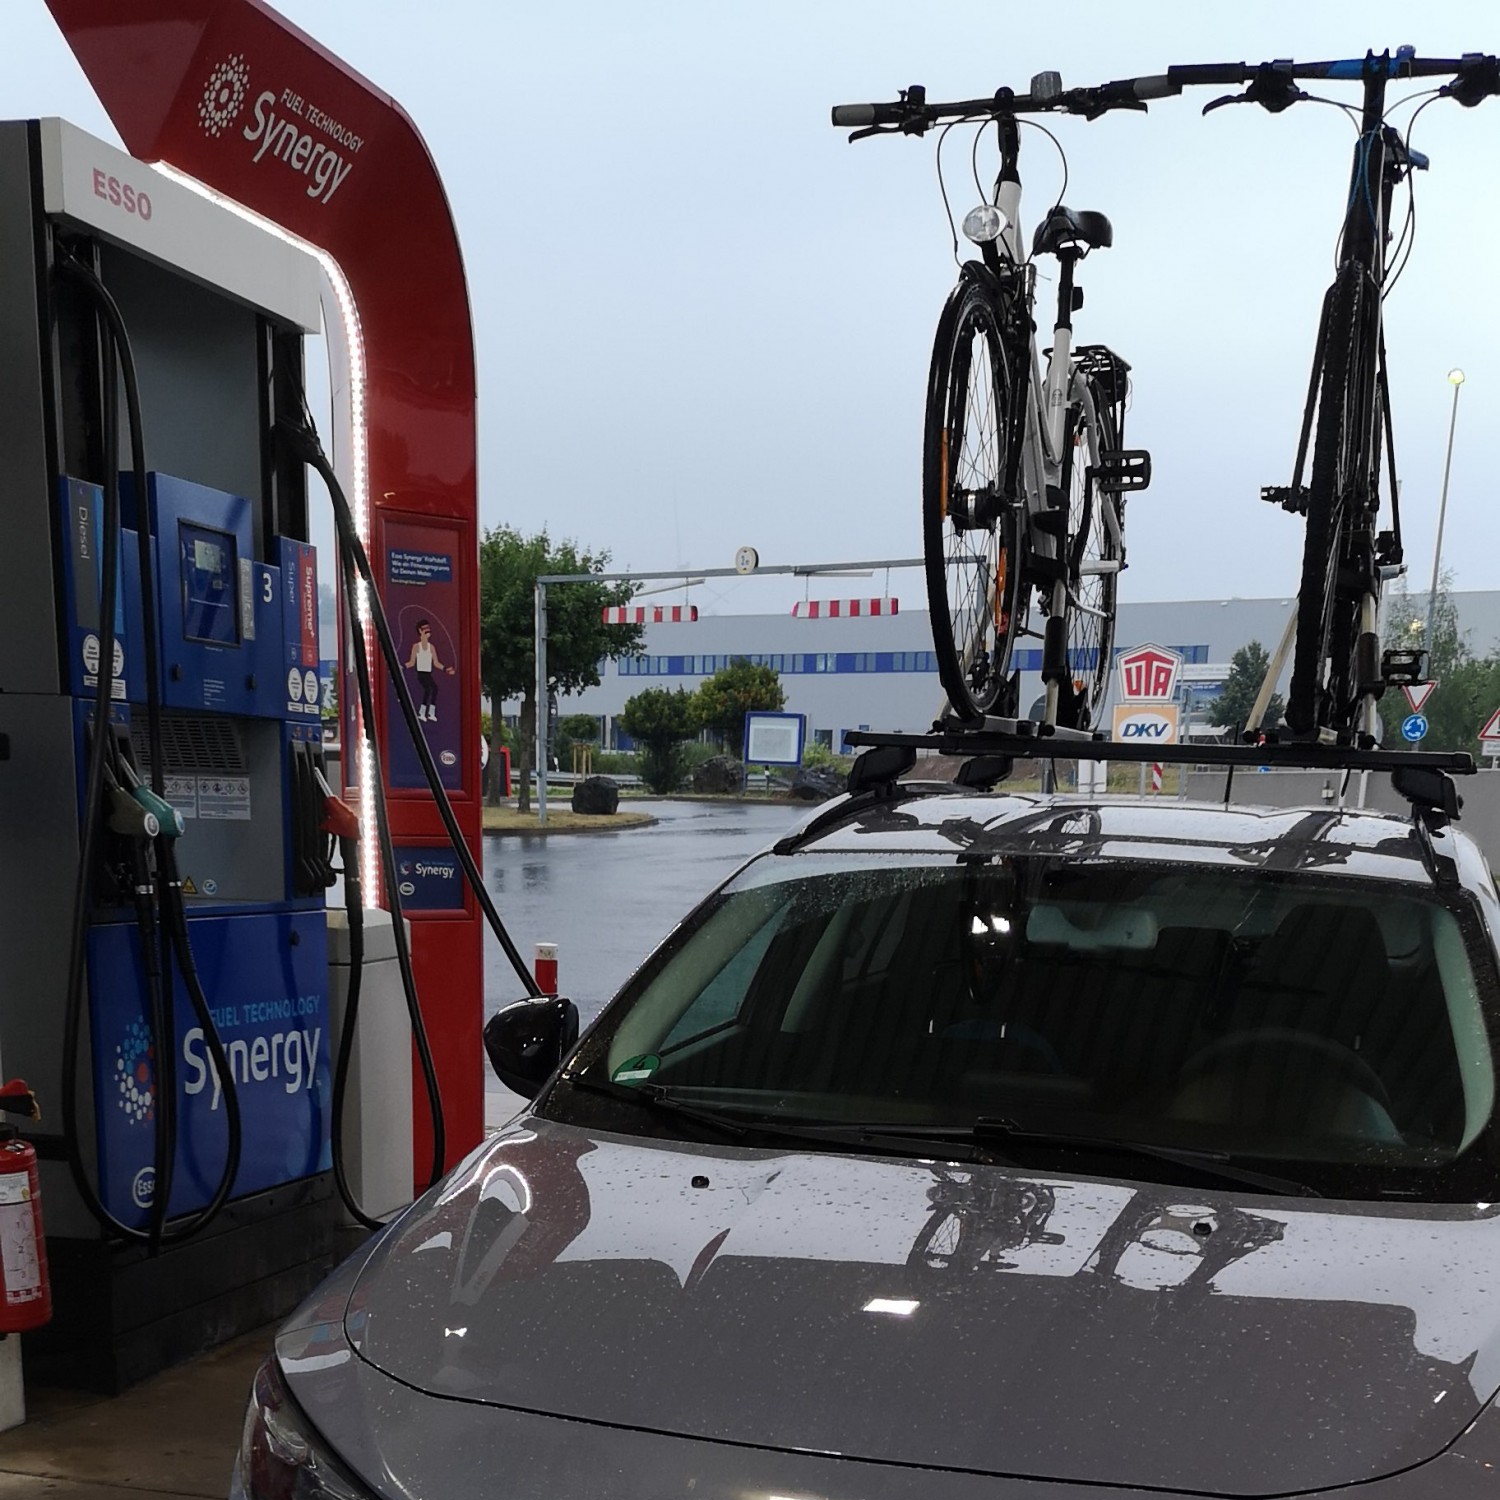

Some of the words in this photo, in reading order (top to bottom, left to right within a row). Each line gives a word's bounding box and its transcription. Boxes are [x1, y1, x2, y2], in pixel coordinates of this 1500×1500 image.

[280, 88, 303, 115] FUEL
[305, 104, 364, 153] TECHNOLOGY
[243, 90, 353, 204] Synergy
[92, 168, 152, 221] ESSO
[79, 506, 90, 559] Diesel
[262, 572, 273, 603] 3
[287, 561, 295, 605] Super
[1124, 650, 1175, 697] UTA
[1122, 723, 1169, 737] DKV
[415, 862, 455, 879] Synergy
[208, 1006, 240, 1027] FUEL
[243, 995, 321, 1023] TECHNOLOGY
[183, 1027, 321, 1110] Synergy
[633, 1054, 649, 1071] 4
